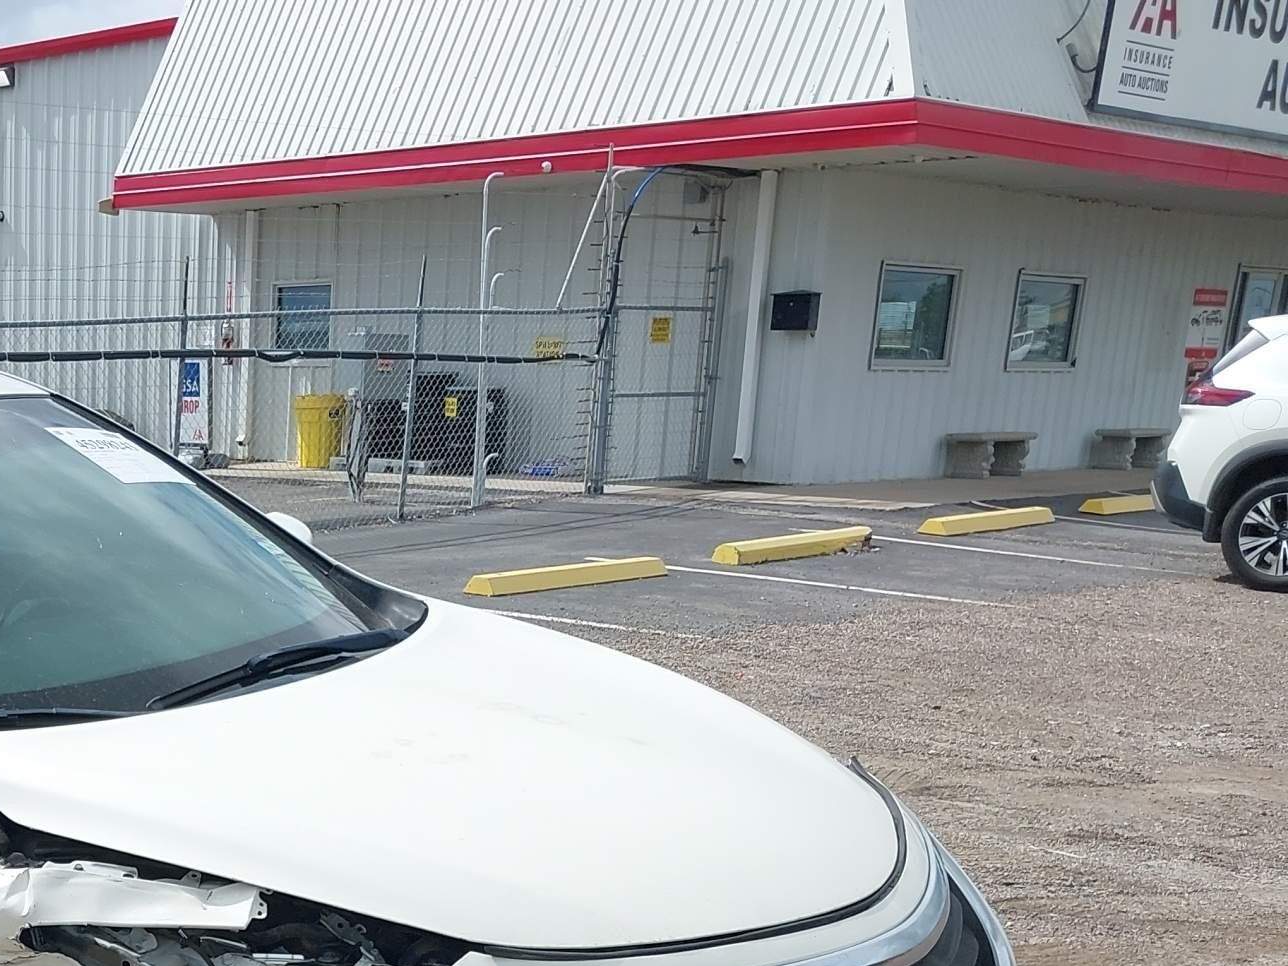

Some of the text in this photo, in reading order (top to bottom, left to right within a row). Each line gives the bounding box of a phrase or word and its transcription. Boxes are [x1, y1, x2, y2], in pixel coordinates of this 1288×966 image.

[1123, 47, 1173, 69] INSURANCE
[1119, 72, 1169, 94] AUTO AUCTIONS
[183, 400, 199, 414] ROP
